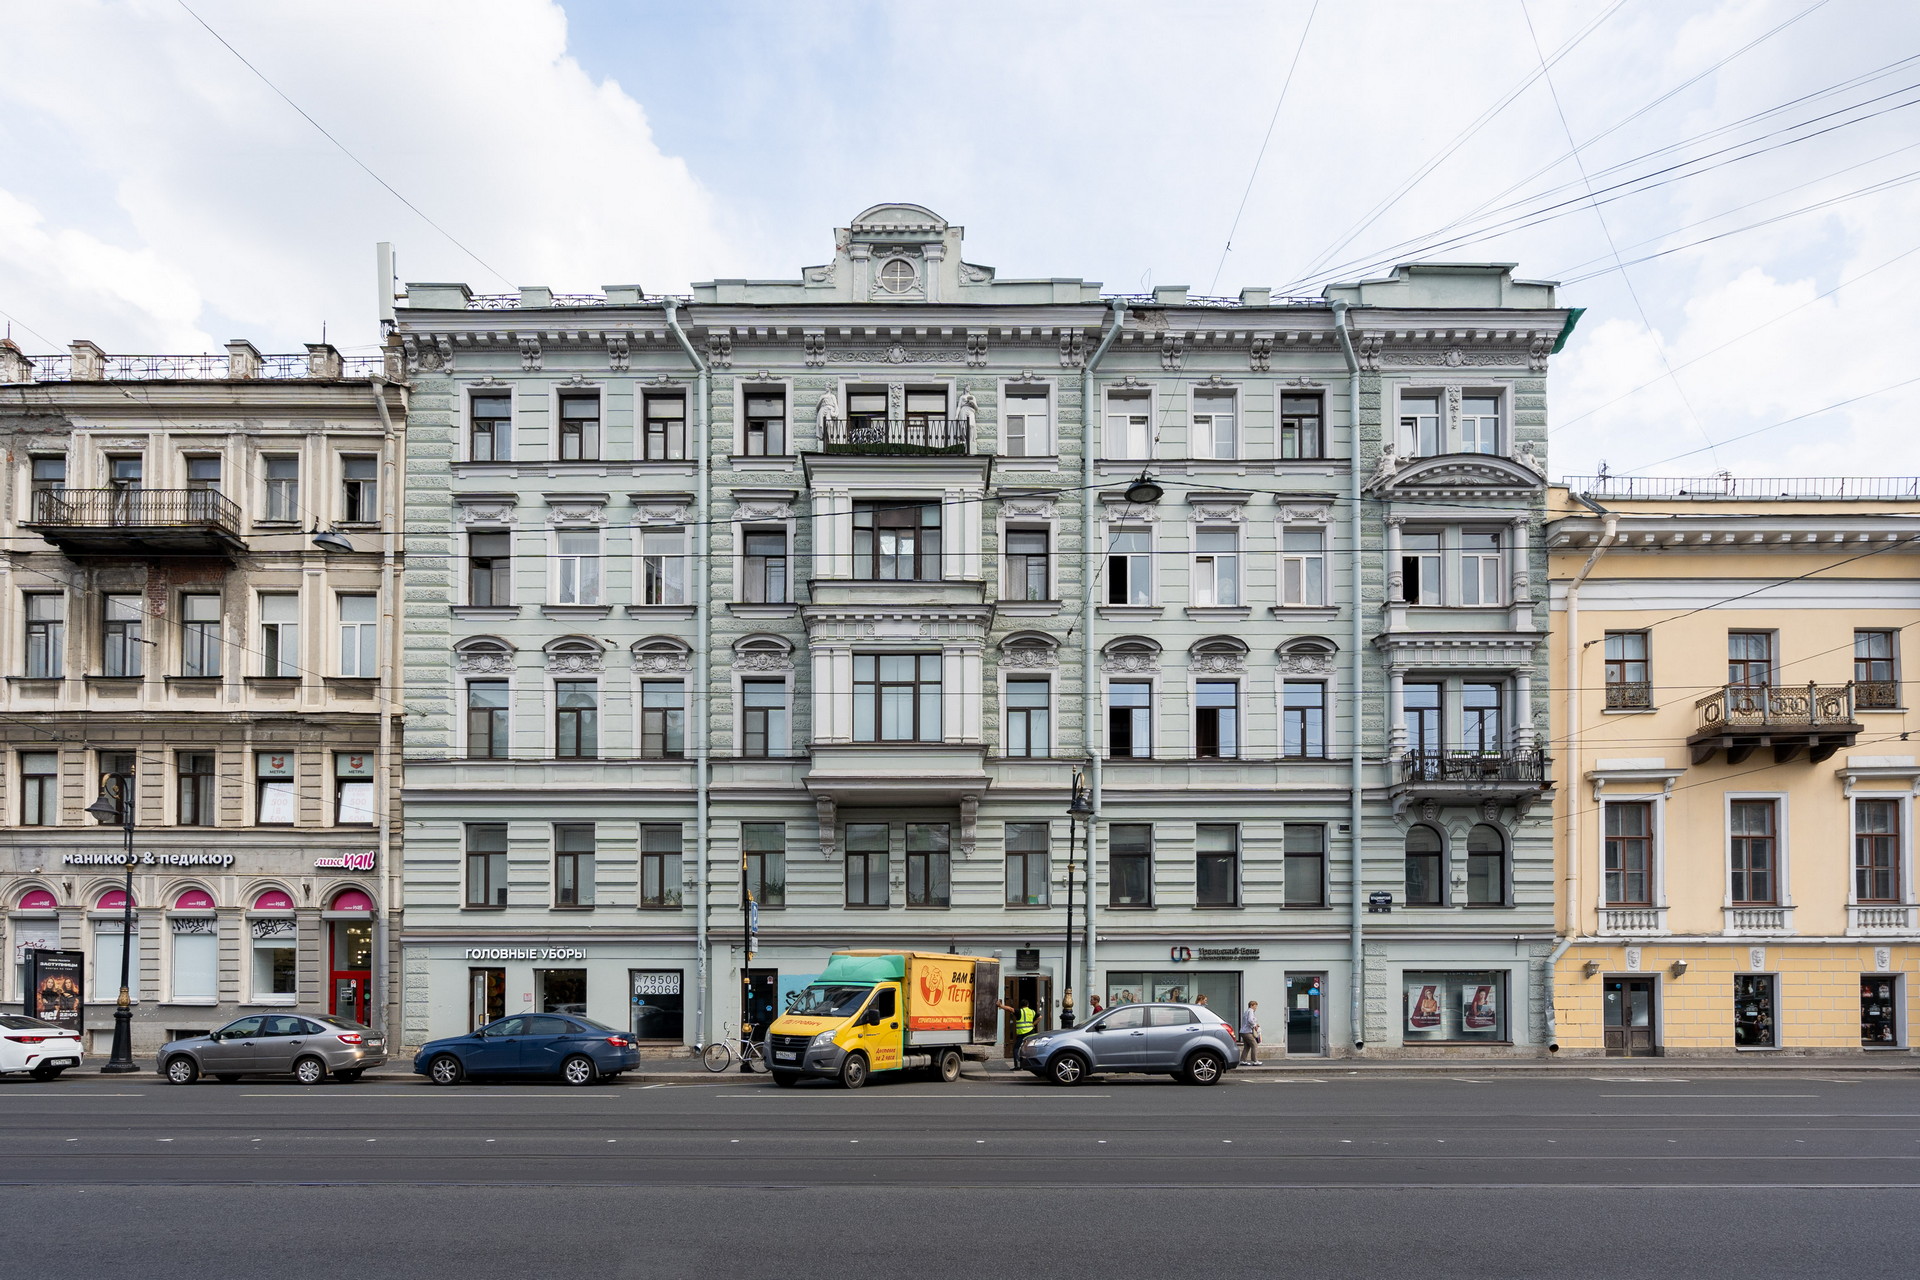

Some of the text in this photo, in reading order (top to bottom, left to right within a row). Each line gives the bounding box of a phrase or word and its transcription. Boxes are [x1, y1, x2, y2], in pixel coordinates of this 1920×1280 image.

[143, 851, 155, 865] &
[160, 852, 234, 868] педикюр
[465, 949, 586, 959] ГОЛОВНЫЕ УБОРЫ
[643, 975, 679, 984] 79500
[952, 972, 968, 984] ВАМ
[636, 985, 679, 994] 023066
